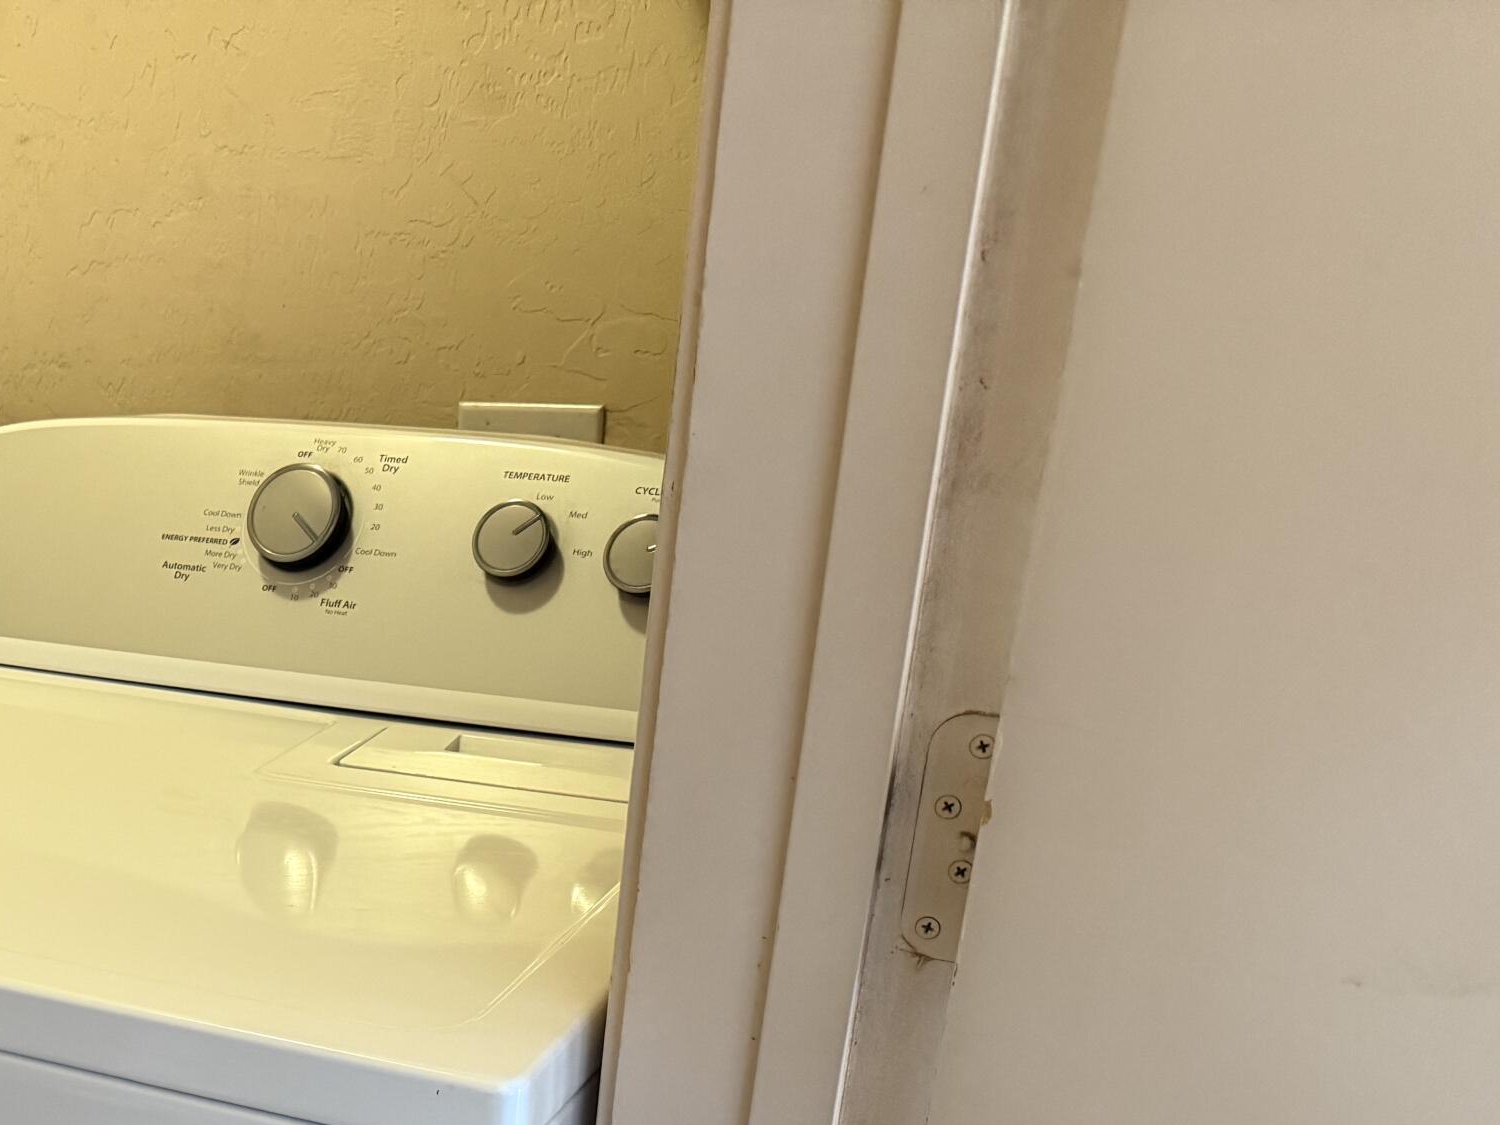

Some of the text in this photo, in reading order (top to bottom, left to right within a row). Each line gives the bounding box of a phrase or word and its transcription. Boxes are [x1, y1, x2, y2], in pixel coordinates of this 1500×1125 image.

[314, 438, 337, 448] Heavy
[298, 450, 313, 458] OFF
[316, 446, 330, 454] Dry
[338, 446, 347, 454] 70
[354, 456, 363, 464] 60
[379, 454, 409, 464] Timed
[238, 469, 264, 478] Wrinkle
[365, 467, 374, 475] 50
[382, 464, 400, 474] Dry
[503, 470, 571, 483] TEMPERATURE
[238, 478, 260, 486] Shield
[372, 484, 382, 492] 40
[635, 486, 661, 496] CYCL
[536, 492, 554, 502] Low
[374, 503, 384, 511] 30
[204, 508, 242, 518] Cool Down
[569, 511, 588, 520] Med
[206, 525, 235, 535] Less Dry
[370, 523, 380, 531] 20
[162, 534, 228, 546] ENERGY PREFERRED
[204, 550, 238, 560] More Dry
[355, 547, 397, 558] Cool Down
[572, 548, 593, 558] High
[162, 560, 206, 573] Automatic
[213, 562, 242, 572] Very Dry
[338, 565, 354, 574] OFF
[174, 571, 190, 582] Dry
[262, 584, 276, 593] OFF
[320, 598, 356, 610] Fluff Air
